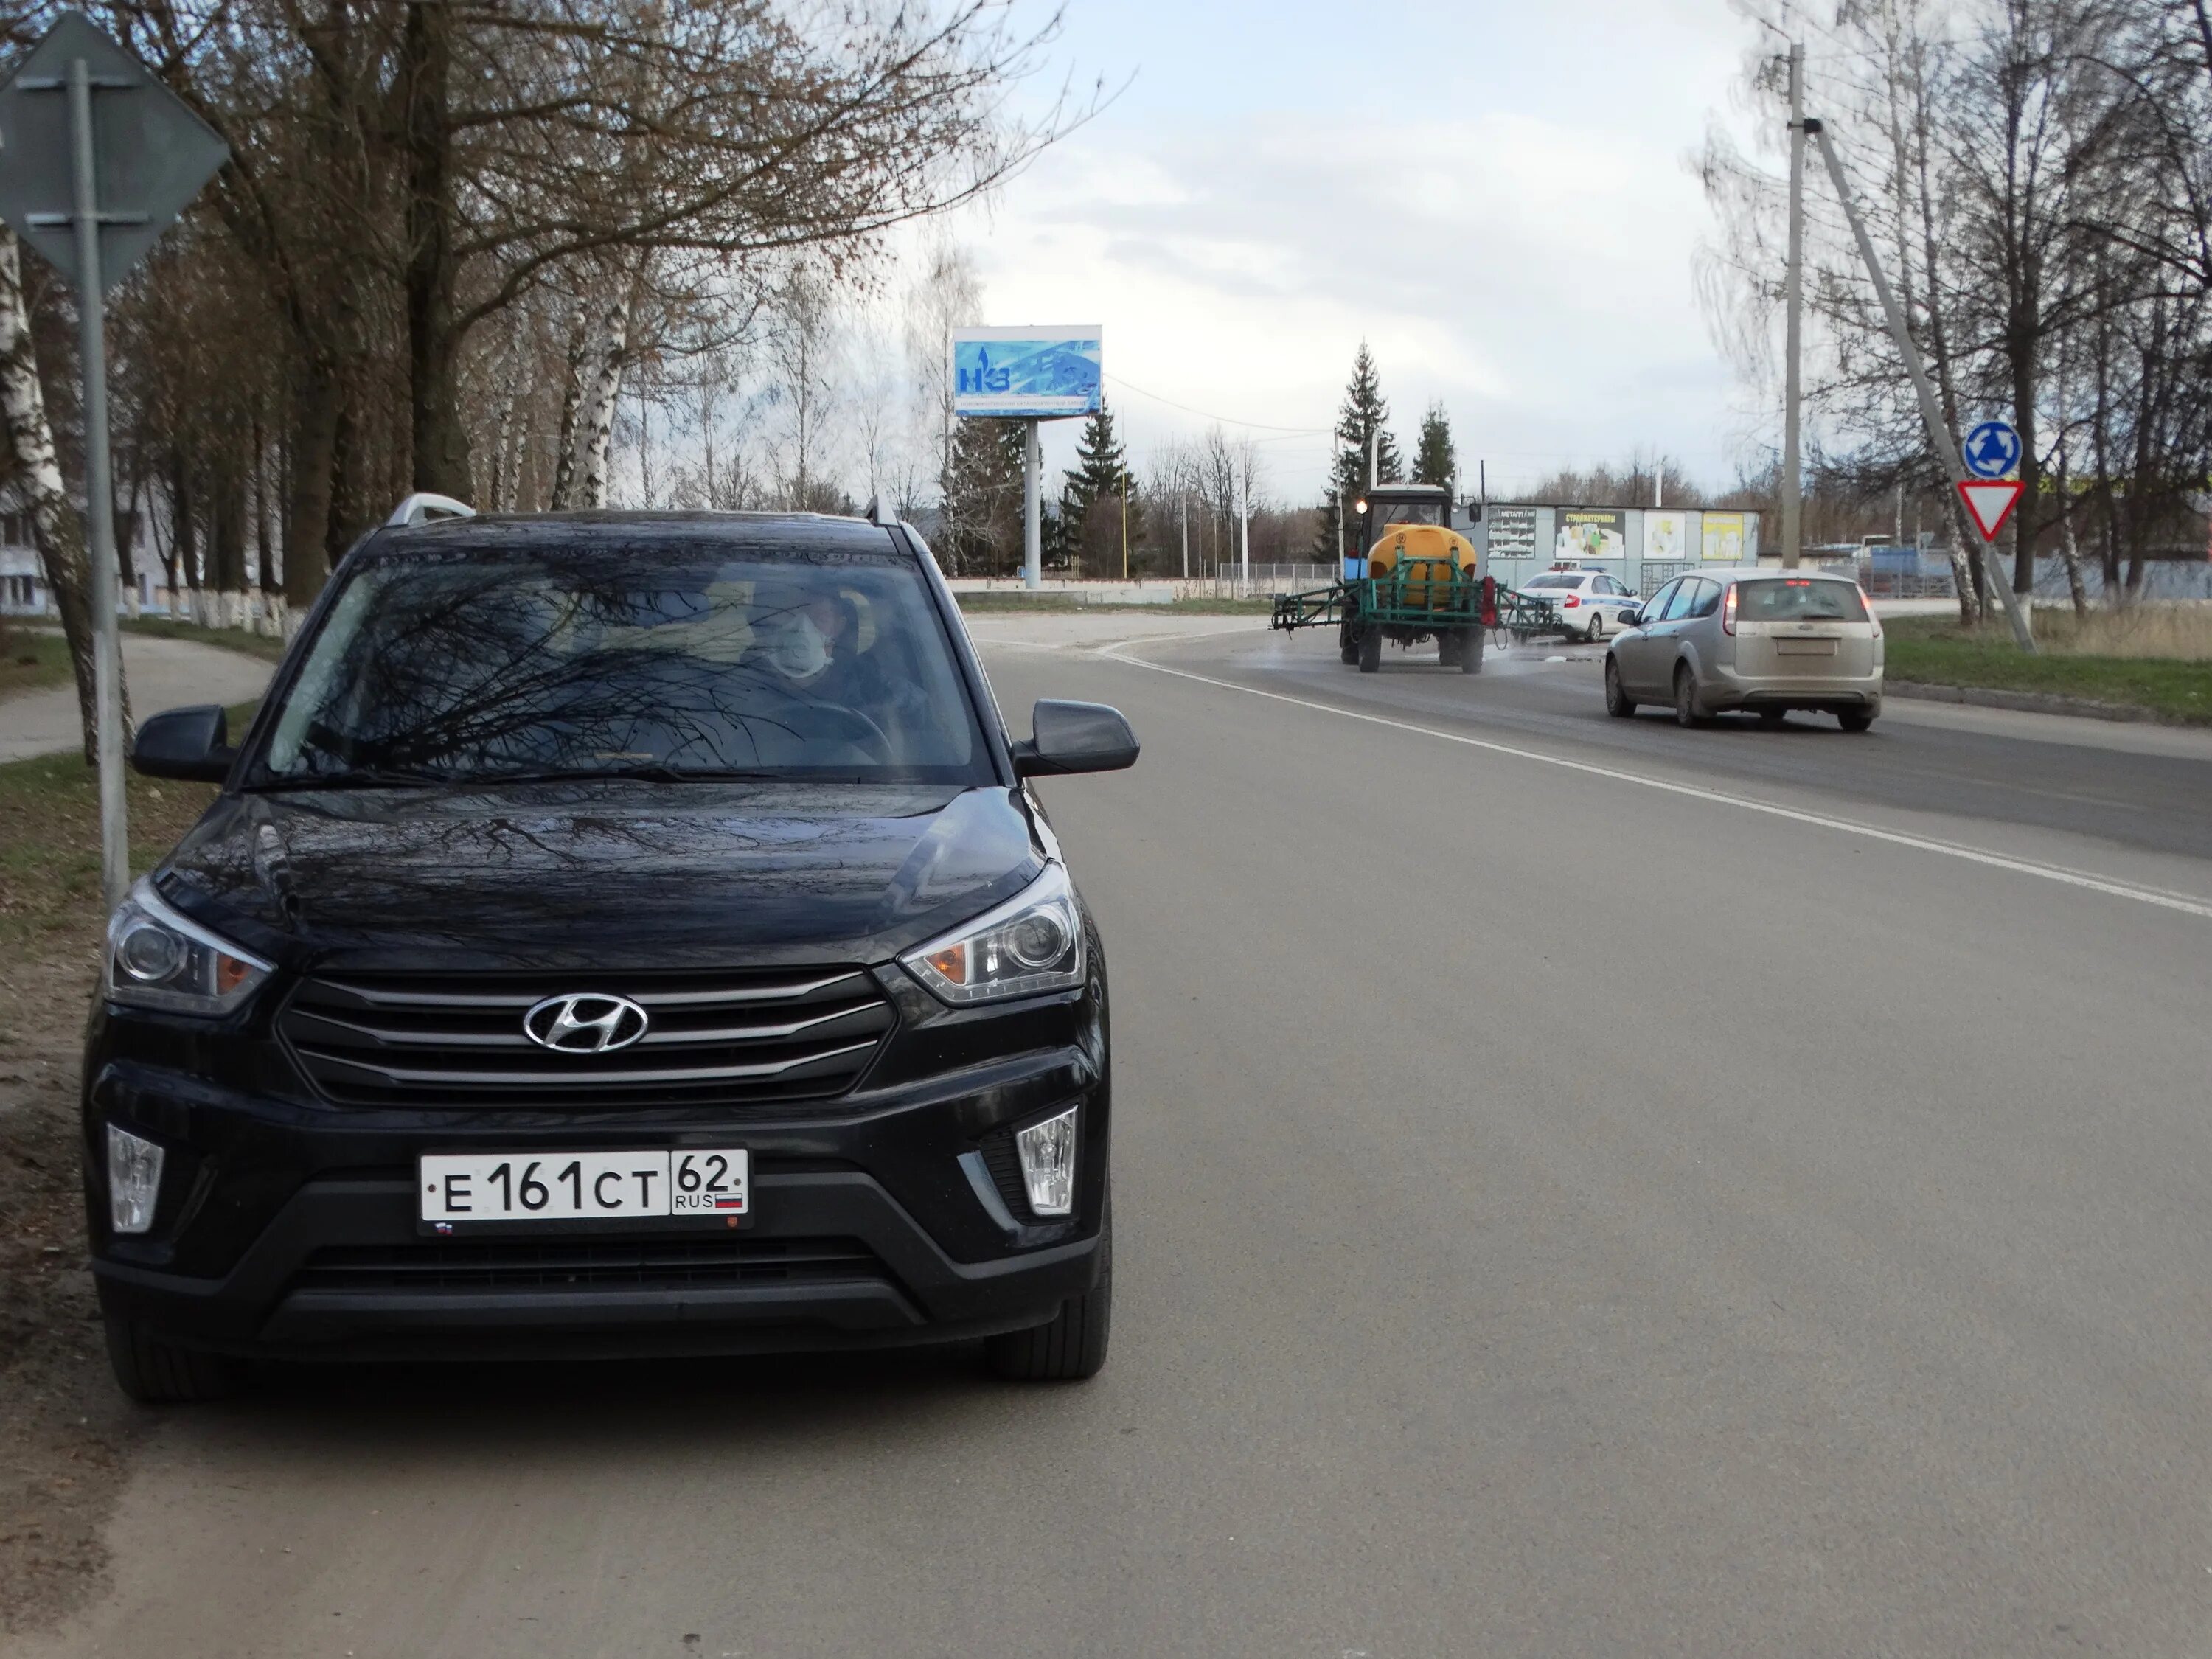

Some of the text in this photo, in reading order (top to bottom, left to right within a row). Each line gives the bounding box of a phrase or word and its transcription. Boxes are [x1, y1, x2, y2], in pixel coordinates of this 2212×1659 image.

[445, 1155, 728, 1211] Е161СТ 62
[675, 1195, 713, 1208] RUS
